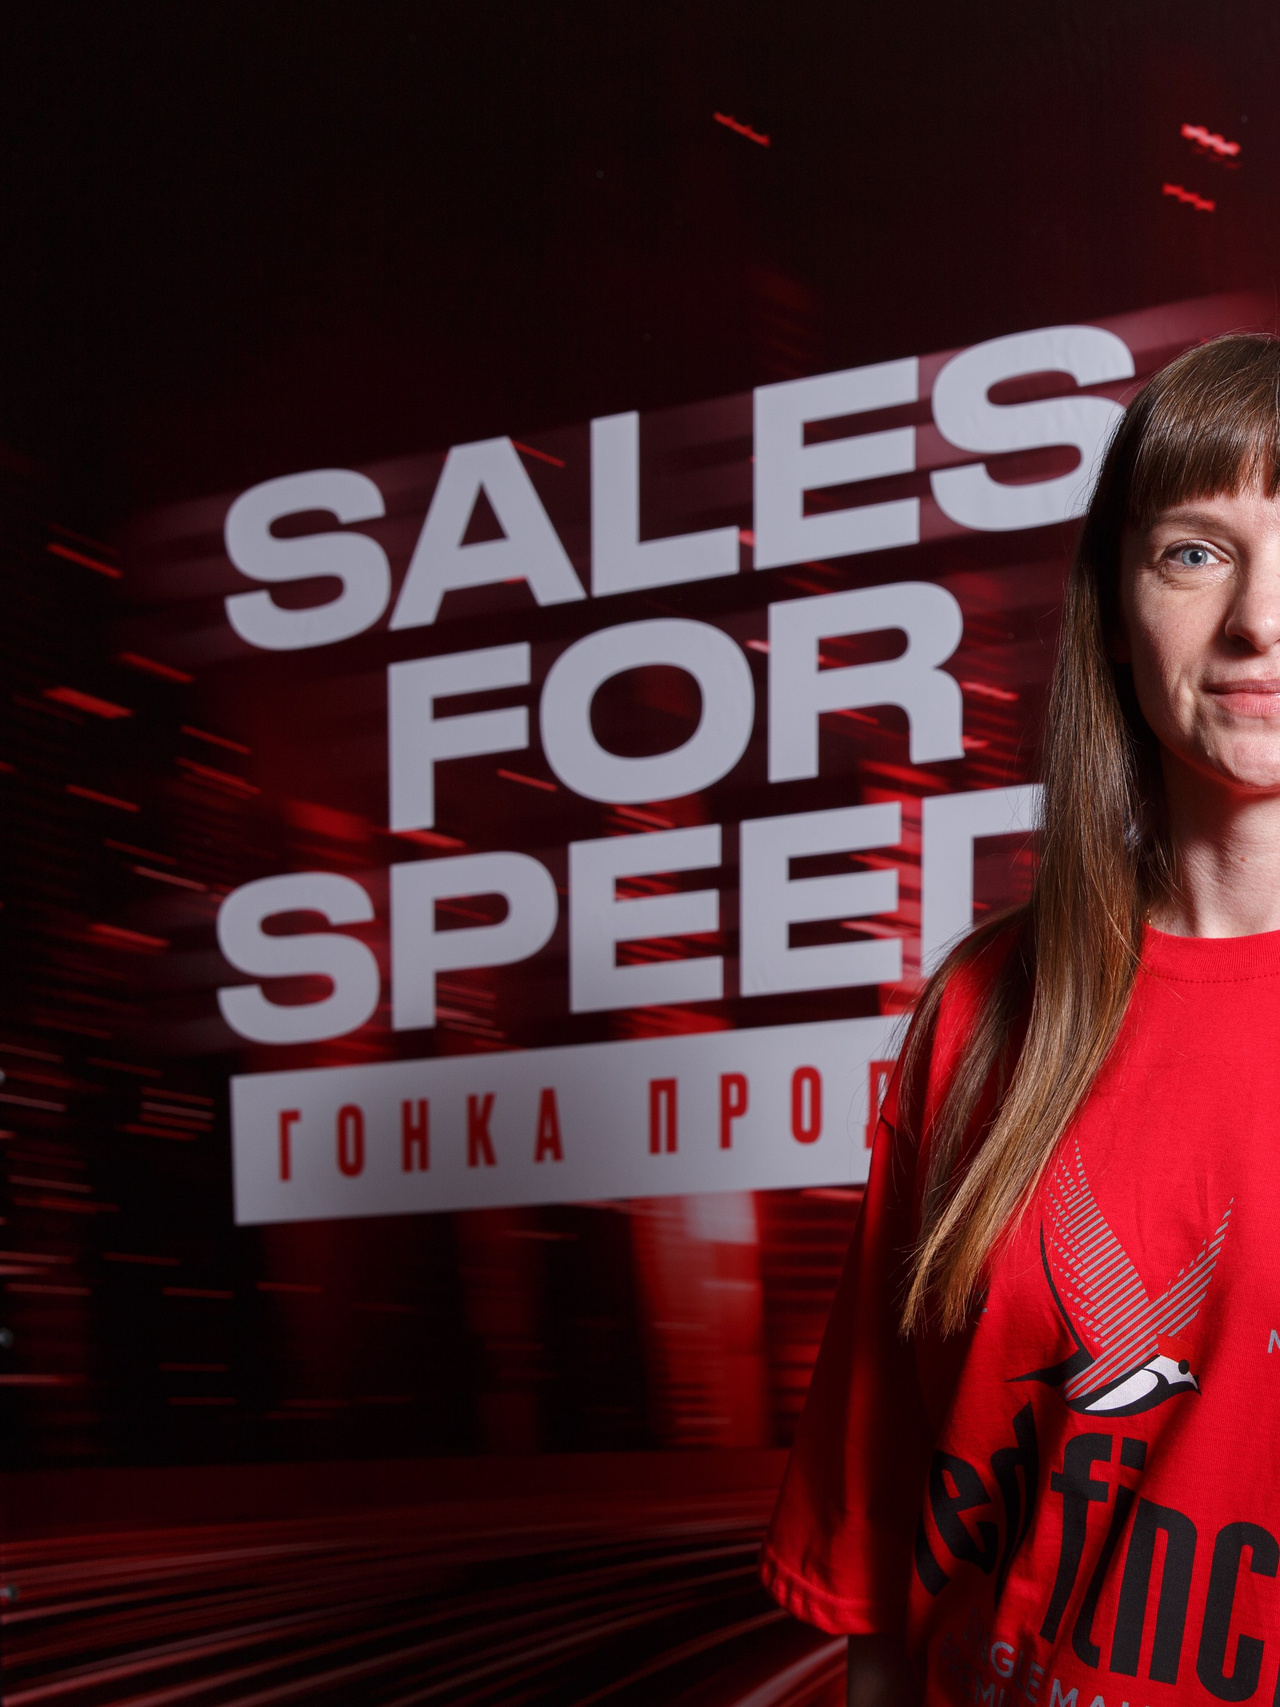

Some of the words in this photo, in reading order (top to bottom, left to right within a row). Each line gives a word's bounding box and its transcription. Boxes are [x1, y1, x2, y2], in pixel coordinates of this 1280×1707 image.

[223, 324, 1137, 651] SALES
[387, 580, 965, 834] FOR
[278, 1087, 565, 1182] ГОНКА
